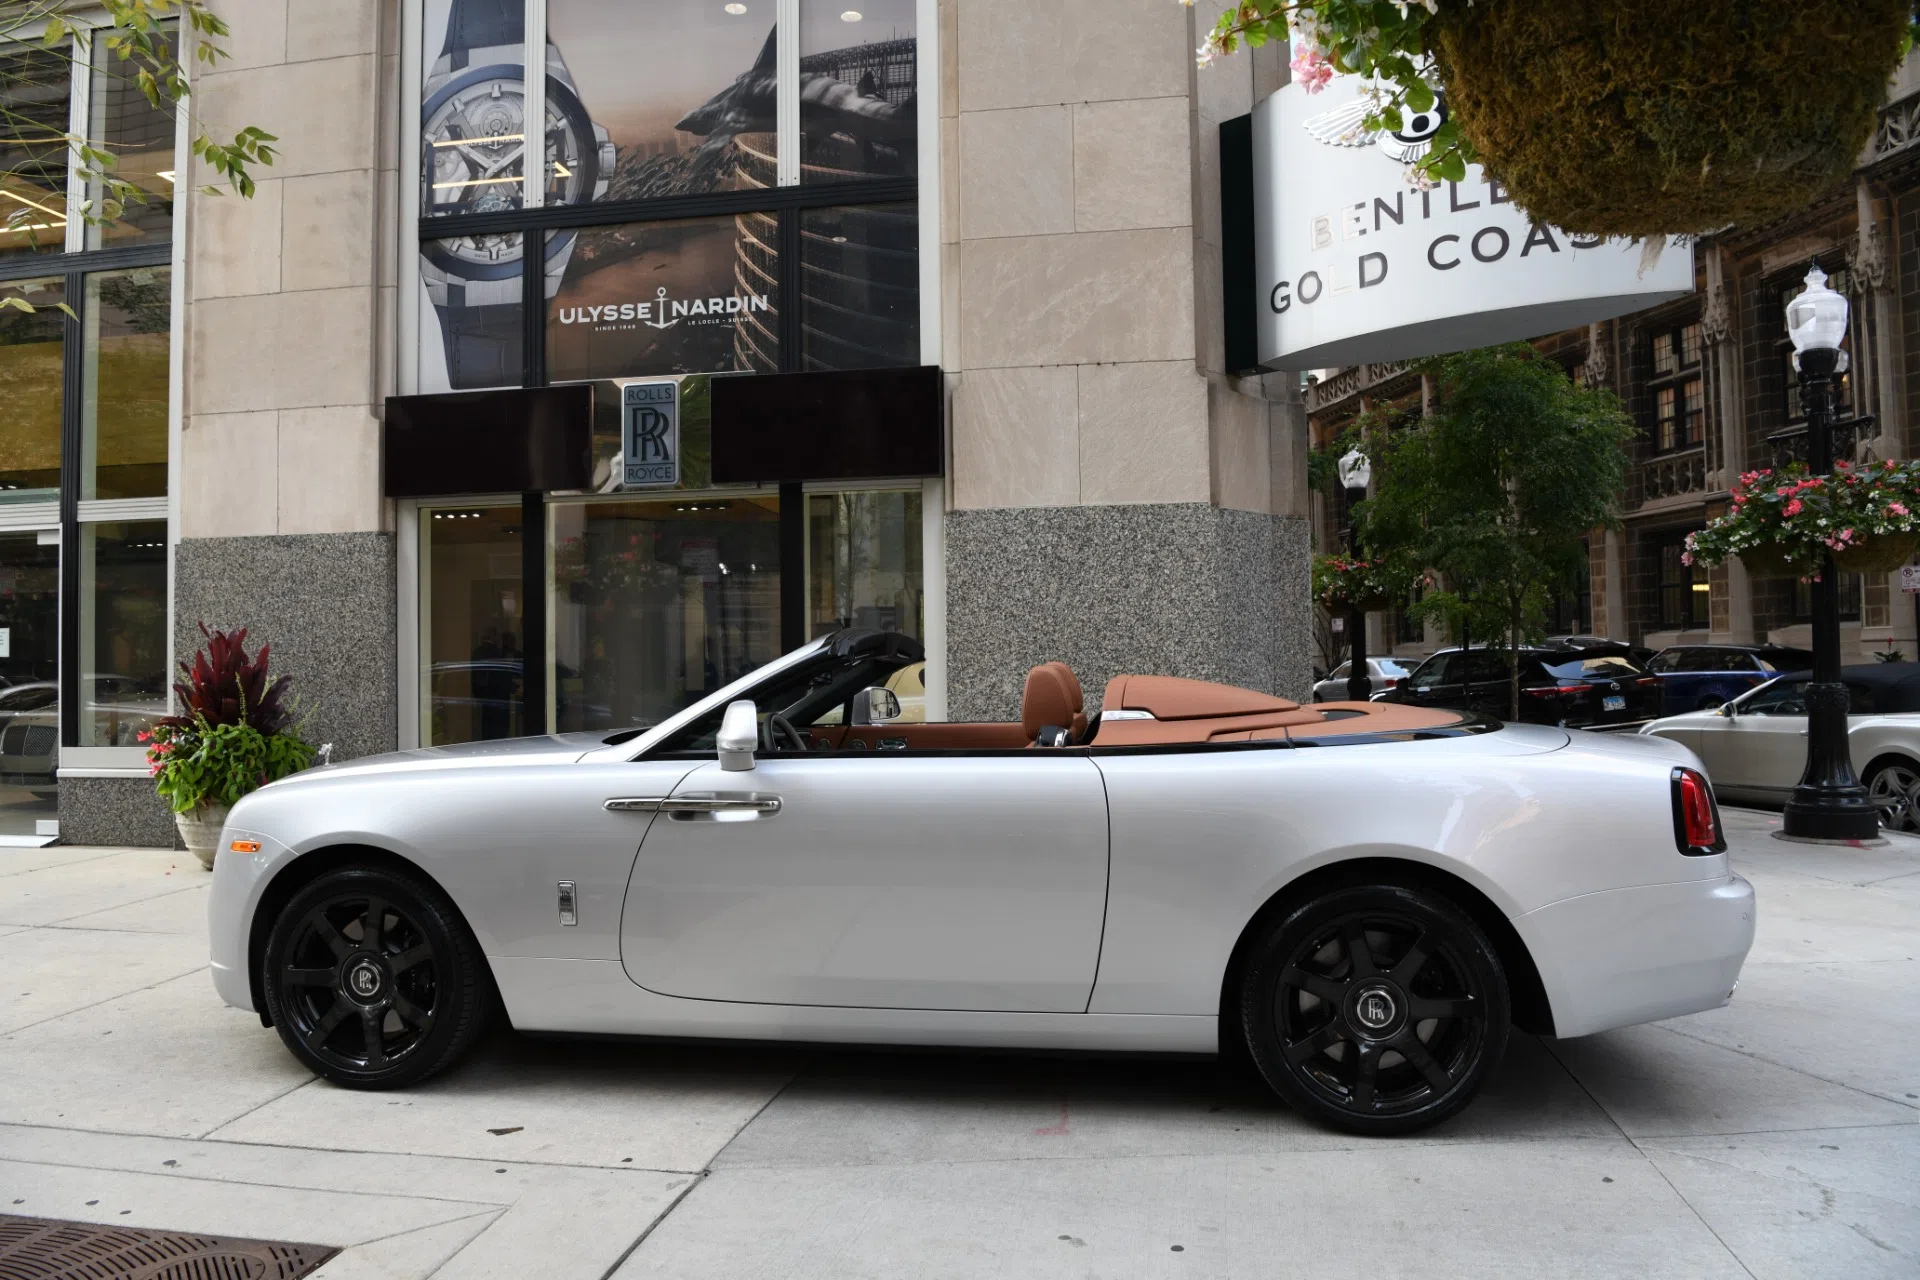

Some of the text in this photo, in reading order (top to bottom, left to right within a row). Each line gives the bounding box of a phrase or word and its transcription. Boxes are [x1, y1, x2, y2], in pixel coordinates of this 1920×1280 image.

[1270, 222, 1601, 314] GOLD COA
[559, 294, 768, 324] ULYSSE NARDIN
[627, 387, 672, 401] ROLLS
[627, 466, 672, 480] ROYCE
